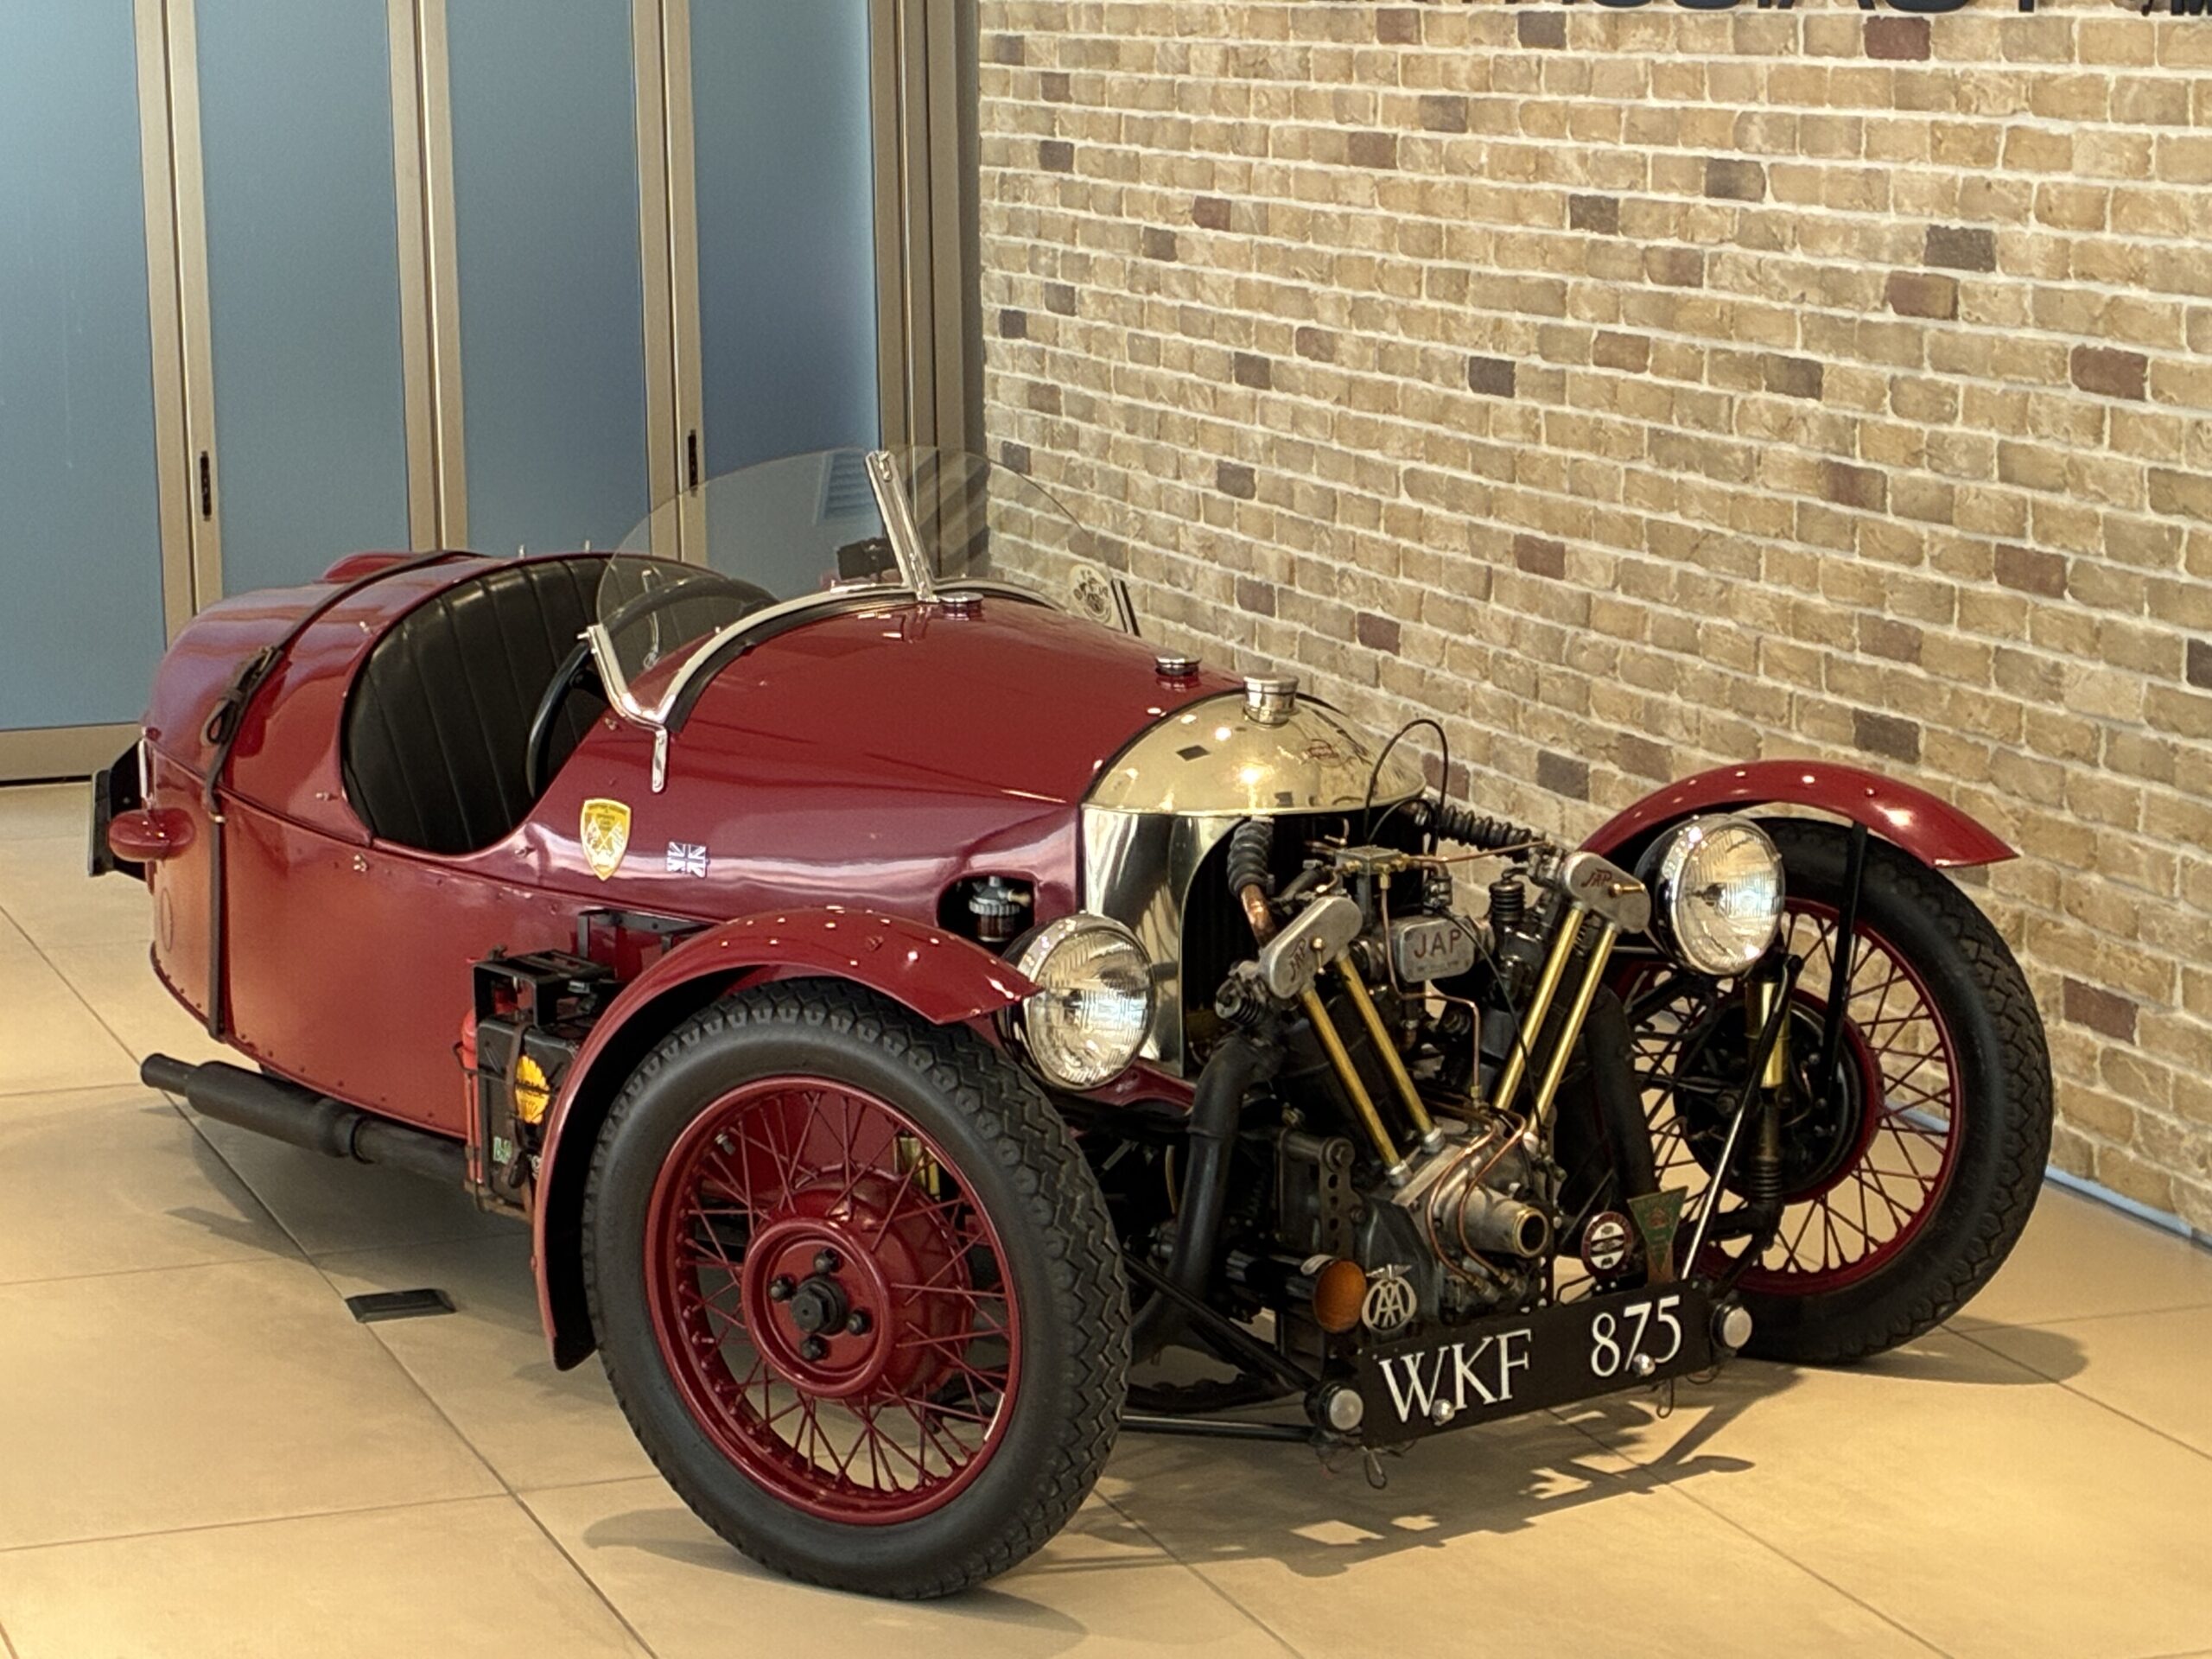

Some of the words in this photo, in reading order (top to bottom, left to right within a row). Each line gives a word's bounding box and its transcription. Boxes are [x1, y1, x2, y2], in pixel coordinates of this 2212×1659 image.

[1414, 928, 1462, 959] JAP
[1369, 1281, 1408, 1328] AA
[1379, 1328, 1531, 1422] WKF
[1591, 1294, 1681, 1376] 875
